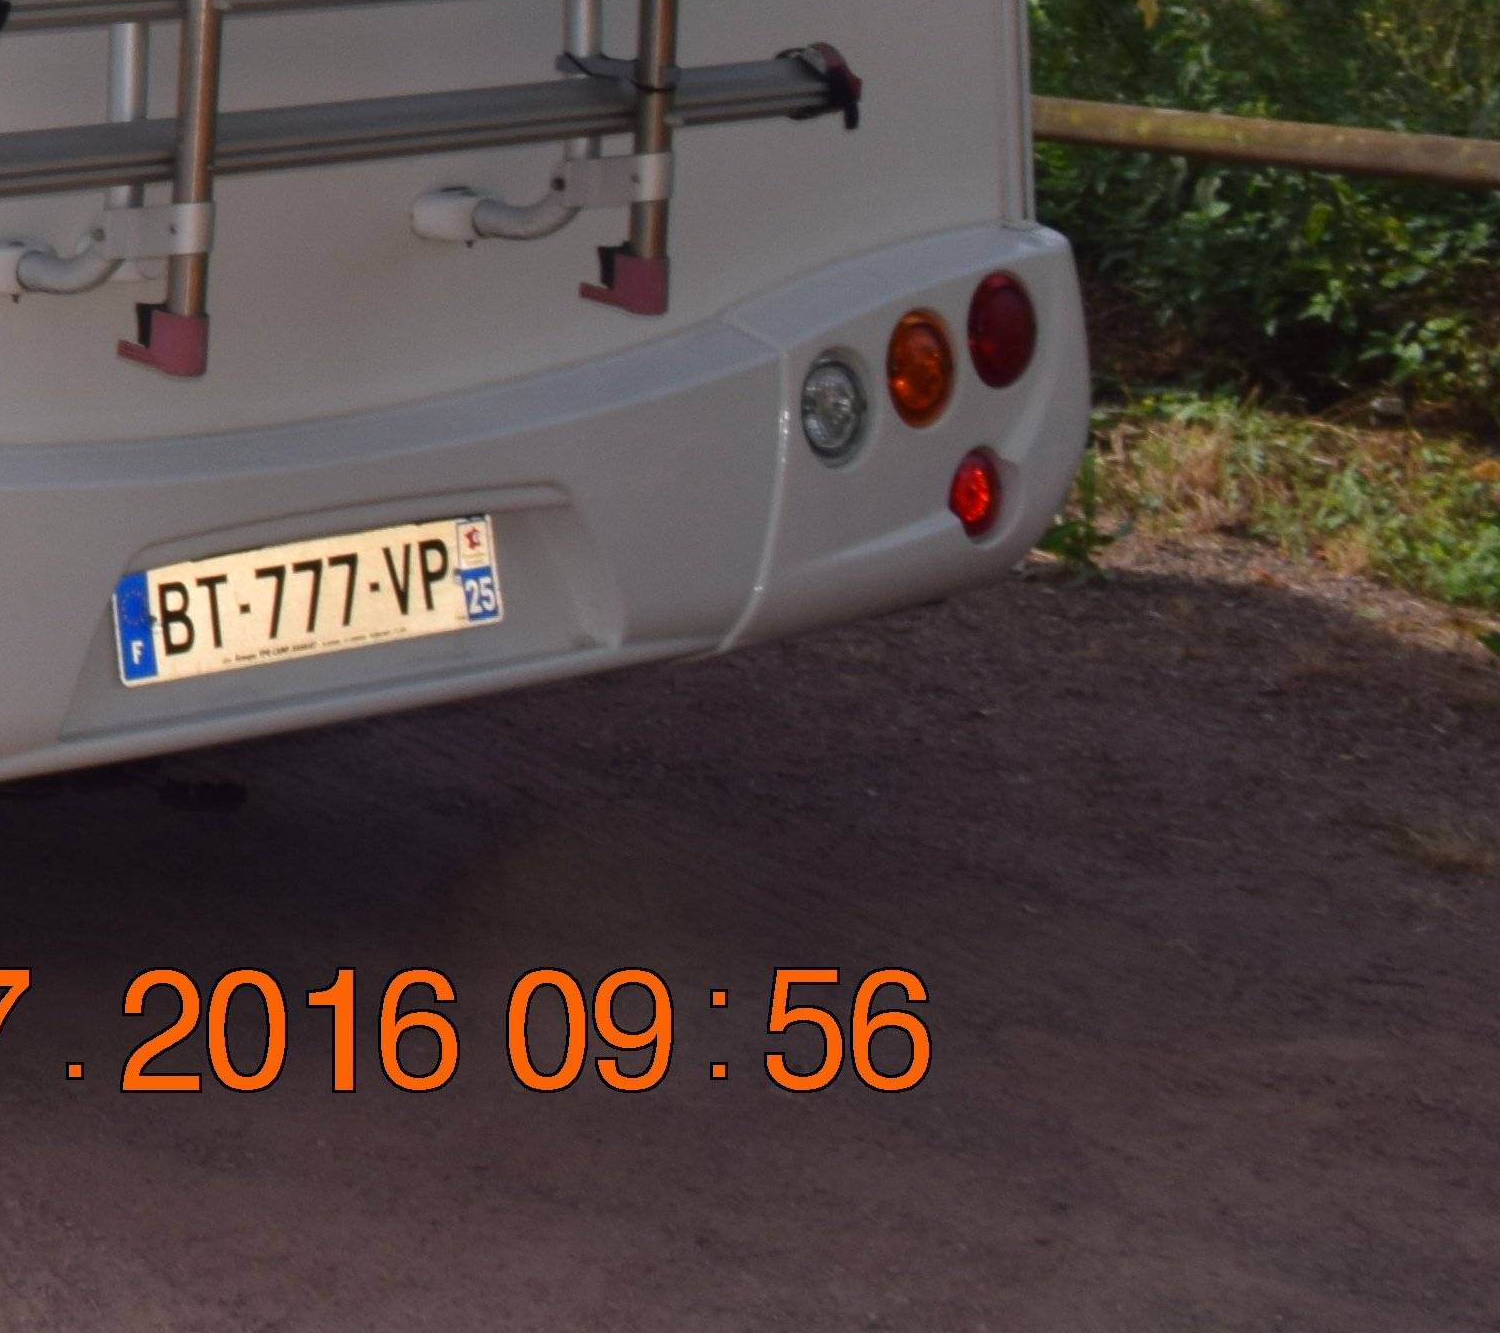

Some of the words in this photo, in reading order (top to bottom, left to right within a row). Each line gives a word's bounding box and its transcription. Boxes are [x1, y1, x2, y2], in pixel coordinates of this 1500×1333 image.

[130, 639, 144, 666] F
[156, 538, 450, 658] BT-777-VP
[463, 576, 497, 615] 25
